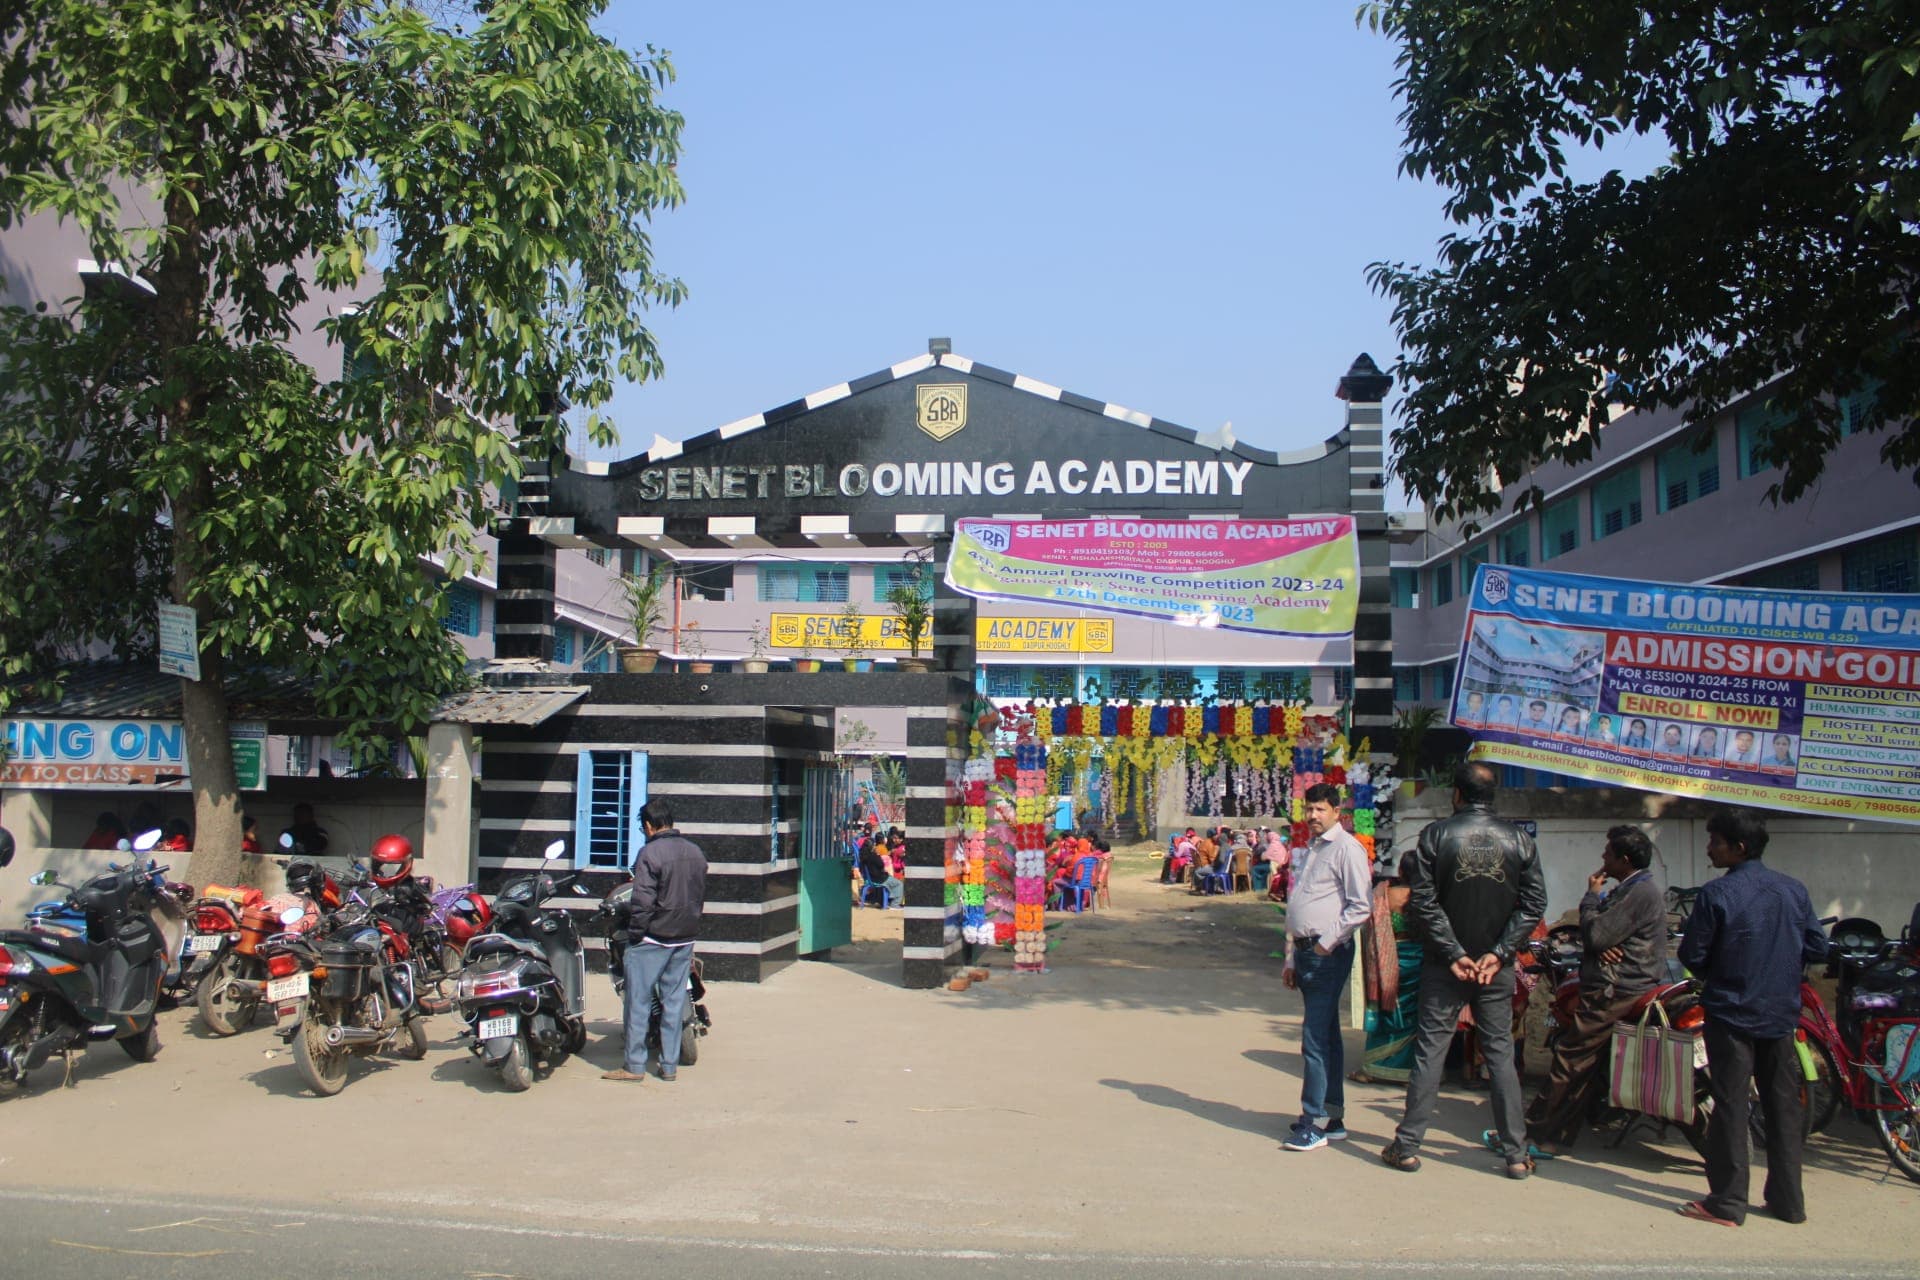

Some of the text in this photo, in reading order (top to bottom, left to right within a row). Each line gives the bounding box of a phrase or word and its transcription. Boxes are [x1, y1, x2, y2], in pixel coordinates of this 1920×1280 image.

[927, 396, 958, 421] SBA
[639, 460, 1253, 500] SENET BLOOMING ACADEMY
[1016, 521, 1338, 540] SENET BLOOMING ACADEMY
[968, 550, 1344, 591] 4th Annual Drawing Competition 2023-24
[1055, 586, 1096, 600] 17th
[1212, 603, 1255, 623] 2023
[1108, 580, 1155, 595] Senet
[1161, 588, 1248, 606] Blooming
[1252, 594, 1330, 611] Academy
[1514, 584, 1619, 615] SENET
[1627, 592, 1832, 631] BLOOMING
[988, 620, 1076, 639] ACADEMY
[1742, 626, 1759, 636] TO
[1611, 635, 1823, 679] ADMISSION
[1618, 667, 1790, 692] FOR SESSION 2024-25 FROM
[1609, 679, 1796, 708] PLAY GROUP TO CLASS IX & XI
[1625, 695, 1774, 726] ENROLL NOW!
[1809, 729, 1842, 741] From
[1822, 720, 1876, 733] HOSTEL
[110, 723, 184, 761] ON
[1804, 745, 1885, 760] INTRODUCING
[1532, 740, 1563, 753] e-mail
[1571, 745, 1711, 777] senetblooming@gmail.com
[1802, 762, 1818, 770] AC
[1821, 763, 1894, 777] CLASSROOM
[31, 765, 59, 780] TO
[66, 766, 132, 781] CLASS
[1701, 784, 1748, 796] CONTACT
[1803, 778, 1836, 789] JOINT
[1840, 781, 1904, 795] ENTRANCE
